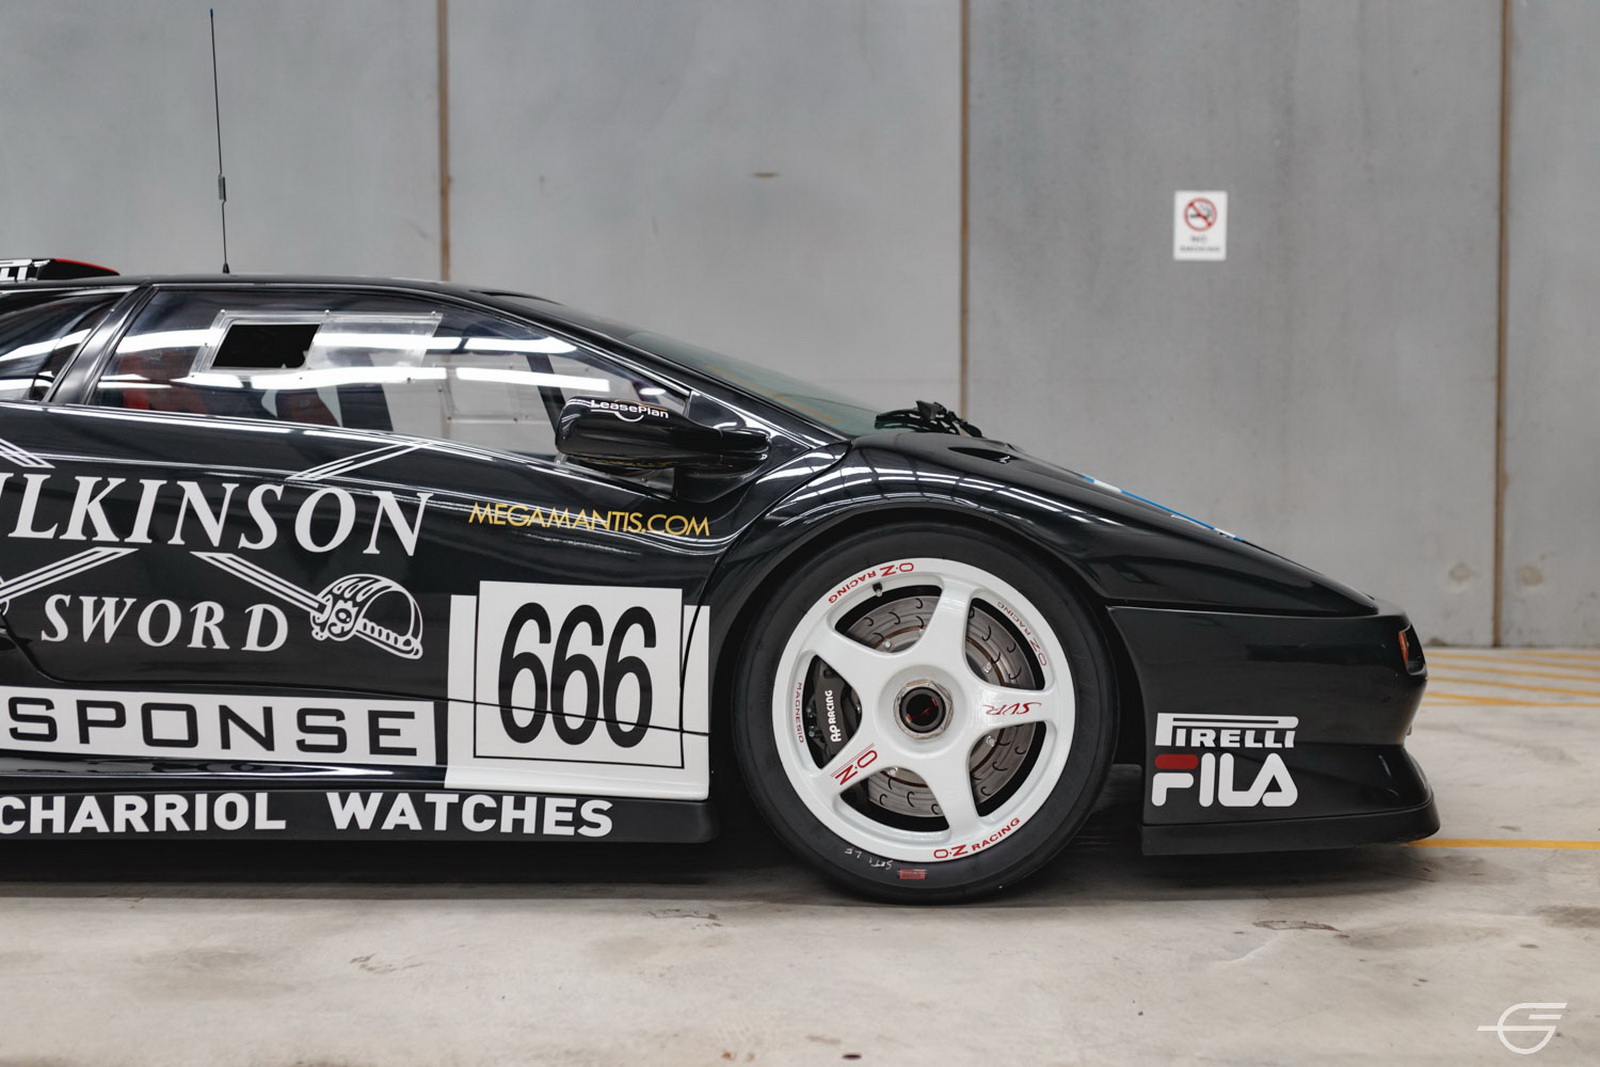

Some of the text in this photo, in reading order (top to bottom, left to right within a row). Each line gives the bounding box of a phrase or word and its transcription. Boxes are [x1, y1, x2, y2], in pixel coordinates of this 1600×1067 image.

[590, 399, 669, 419] LeasePlan
[468, 502, 710, 536] MEGAMANTIS.COM
[828, 570, 877, 604] RACING
[41, 594, 288, 651] SWORD
[997, 601, 1031, 636] RACING
[498, 602, 656, 748] 666
[8, 696, 418, 757] SPONSE
[824, 689, 842, 742] AP RACING
[1155, 712, 1299, 748] PIRELLI
[1151, 752, 1298, 808] FILA
[0, 792, 614, 838] CHARRIOL WATCHES
[971, 817, 1020, 851] RACING
